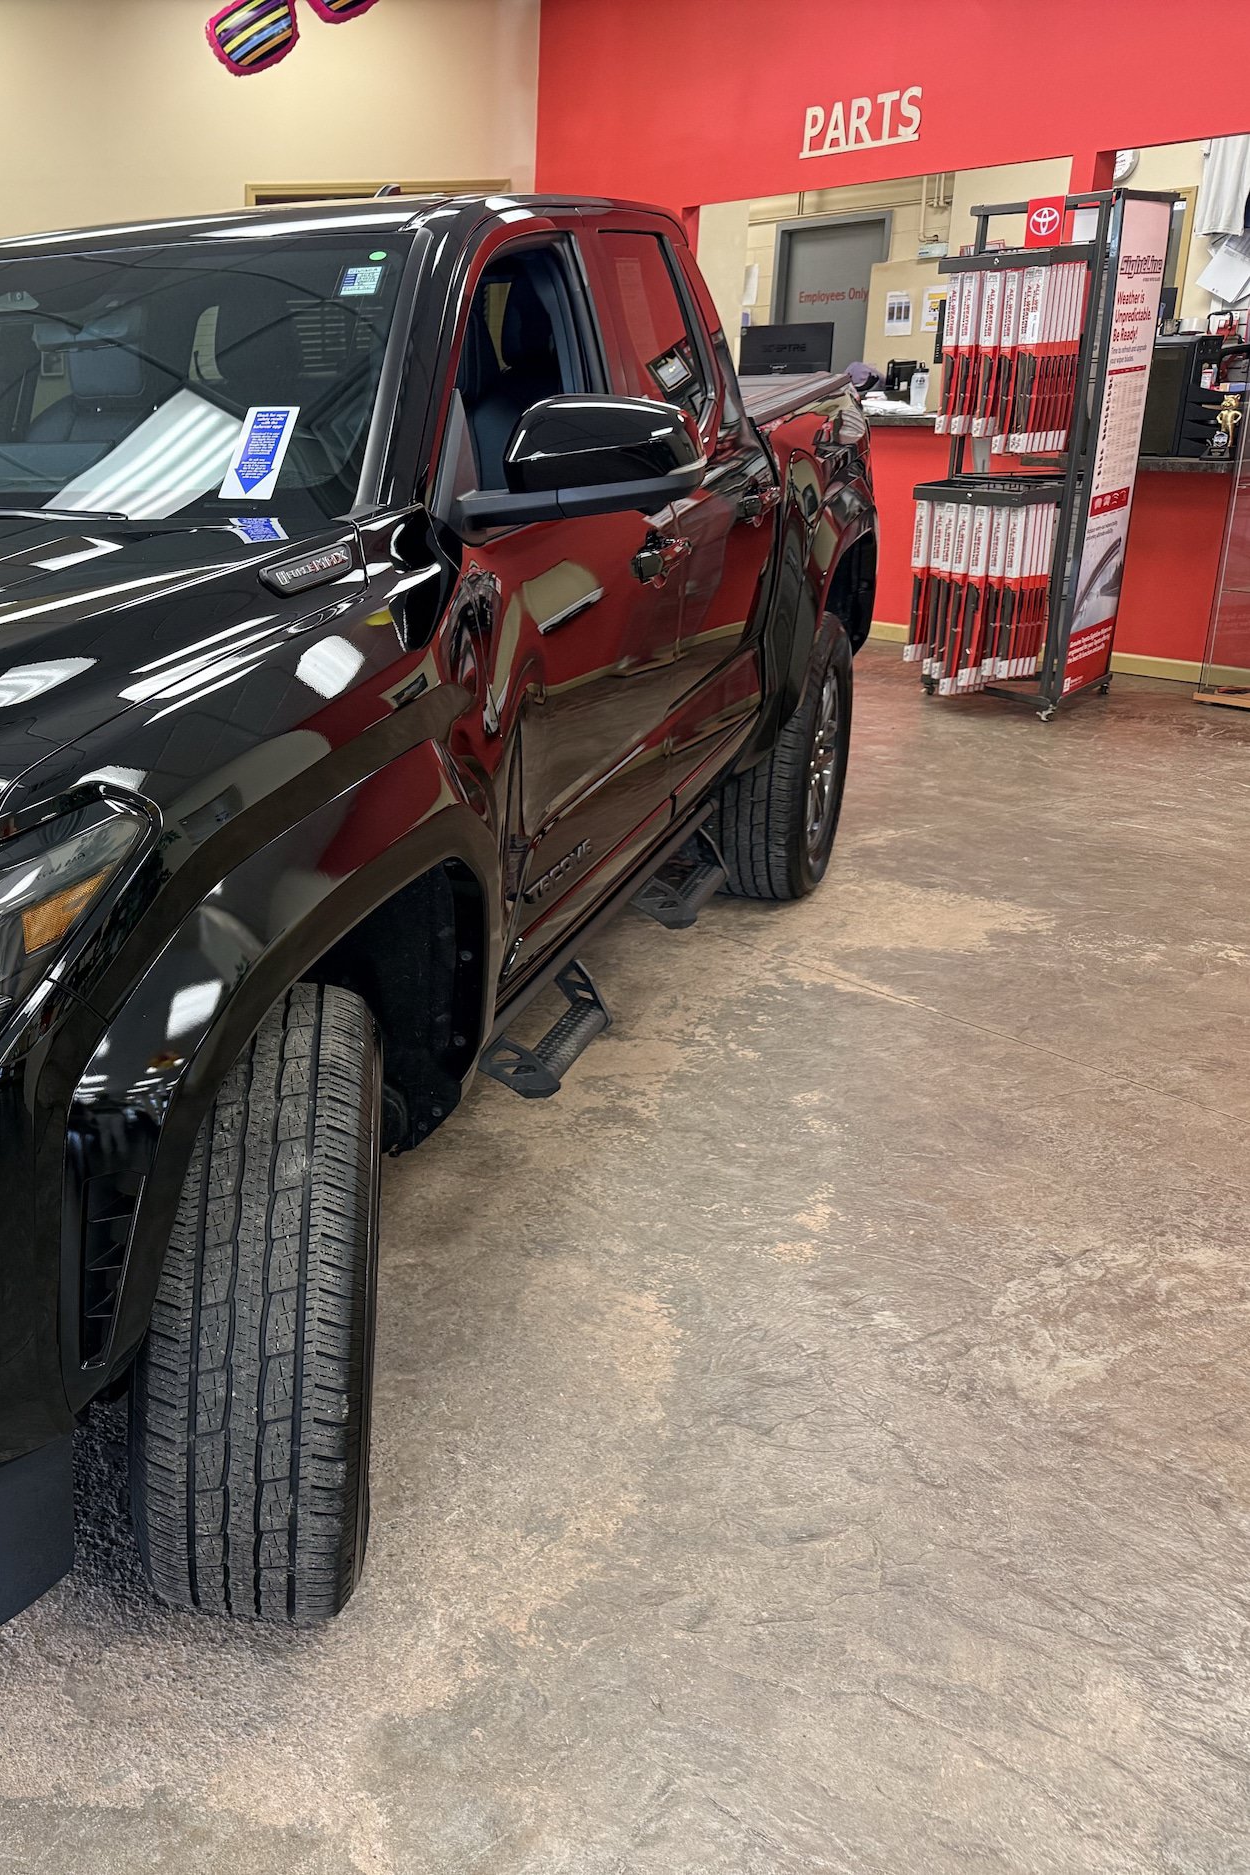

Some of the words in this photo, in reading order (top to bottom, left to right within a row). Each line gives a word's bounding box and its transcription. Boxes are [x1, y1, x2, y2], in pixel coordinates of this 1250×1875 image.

[800, 86, 923, 156] PARTS
[798, 290, 847, 306] Employees
[848, 287, 869, 303] Only
[948, 289, 957, 337] ALL-WEATHER
[987, 288, 996, 337] ALL-WEATHER
[1006, 288, 1015, 337] ALL-WEATHER
[1117, 290, 1140, 305] Weather
[1140, 289, 1145, 304] is
[1115, 307, 1152, 325] Unpredictable.
[1113, 328, 1120, 342] Be
[1120, 326, 1139, 343] Ready!
